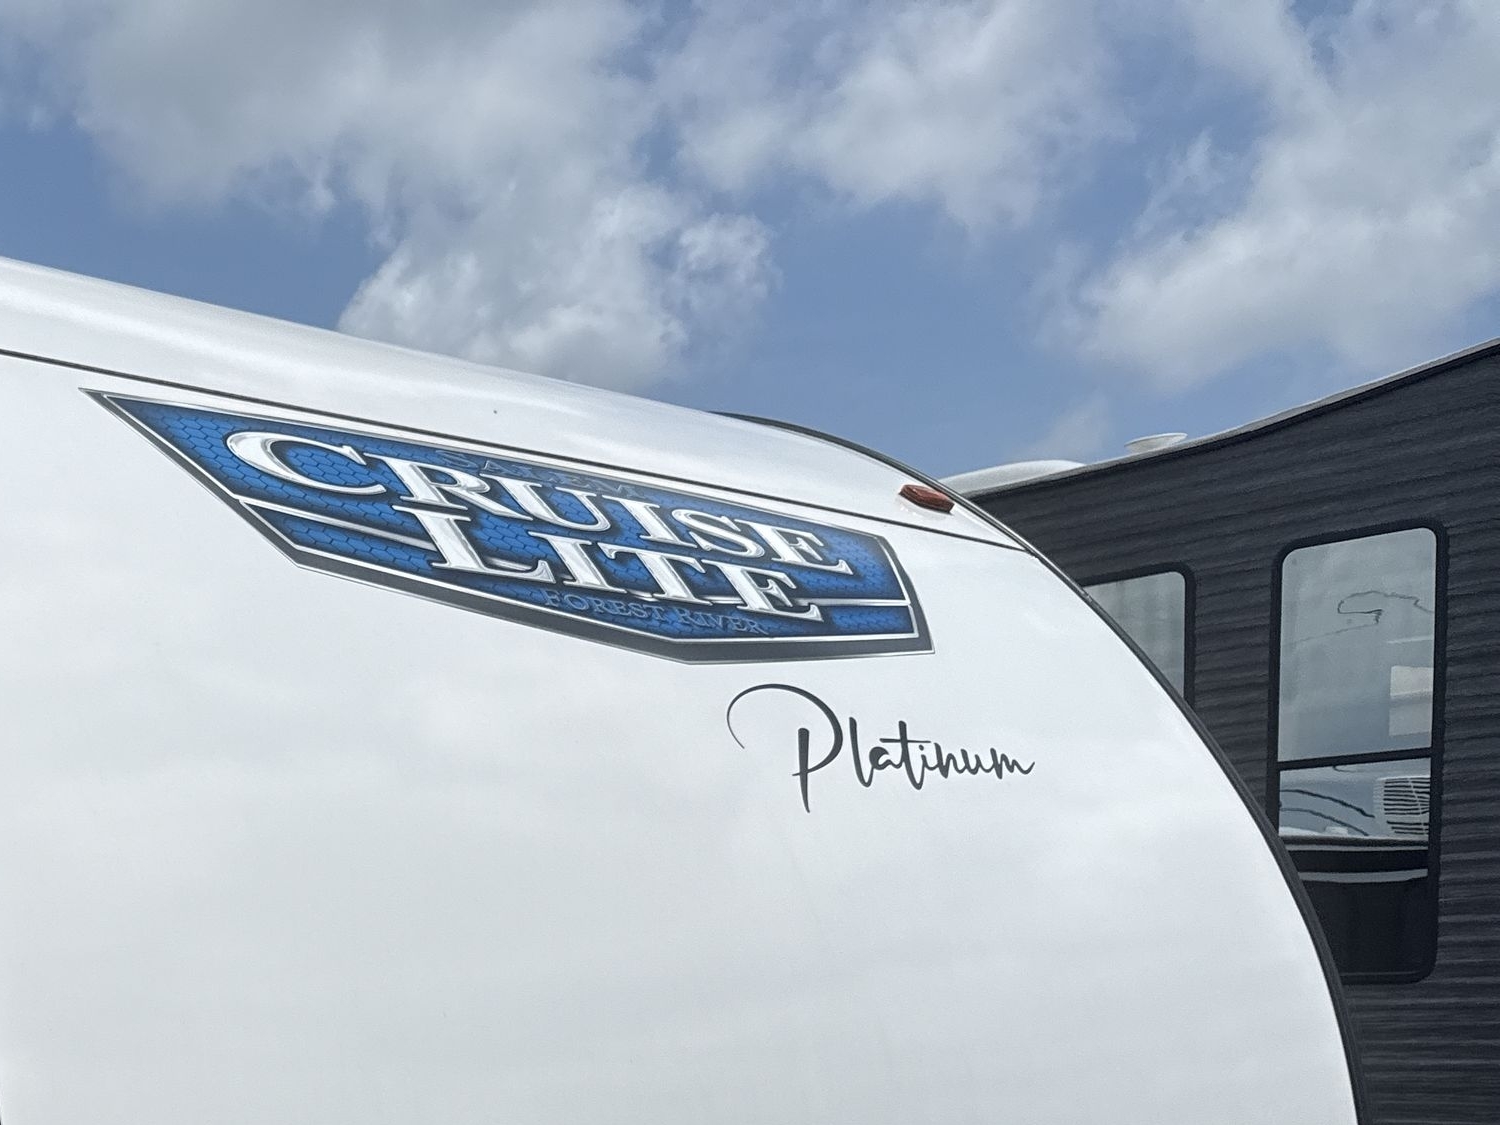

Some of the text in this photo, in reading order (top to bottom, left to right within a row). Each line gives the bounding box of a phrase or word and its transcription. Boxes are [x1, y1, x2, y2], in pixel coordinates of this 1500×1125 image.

[226, 431, 854, 575] CRUISE
[391, 504, 824, 622] LITE
[542, 588, 769, 635] FOREST RIVER
[726, 683, 1035, 813] Platinum
